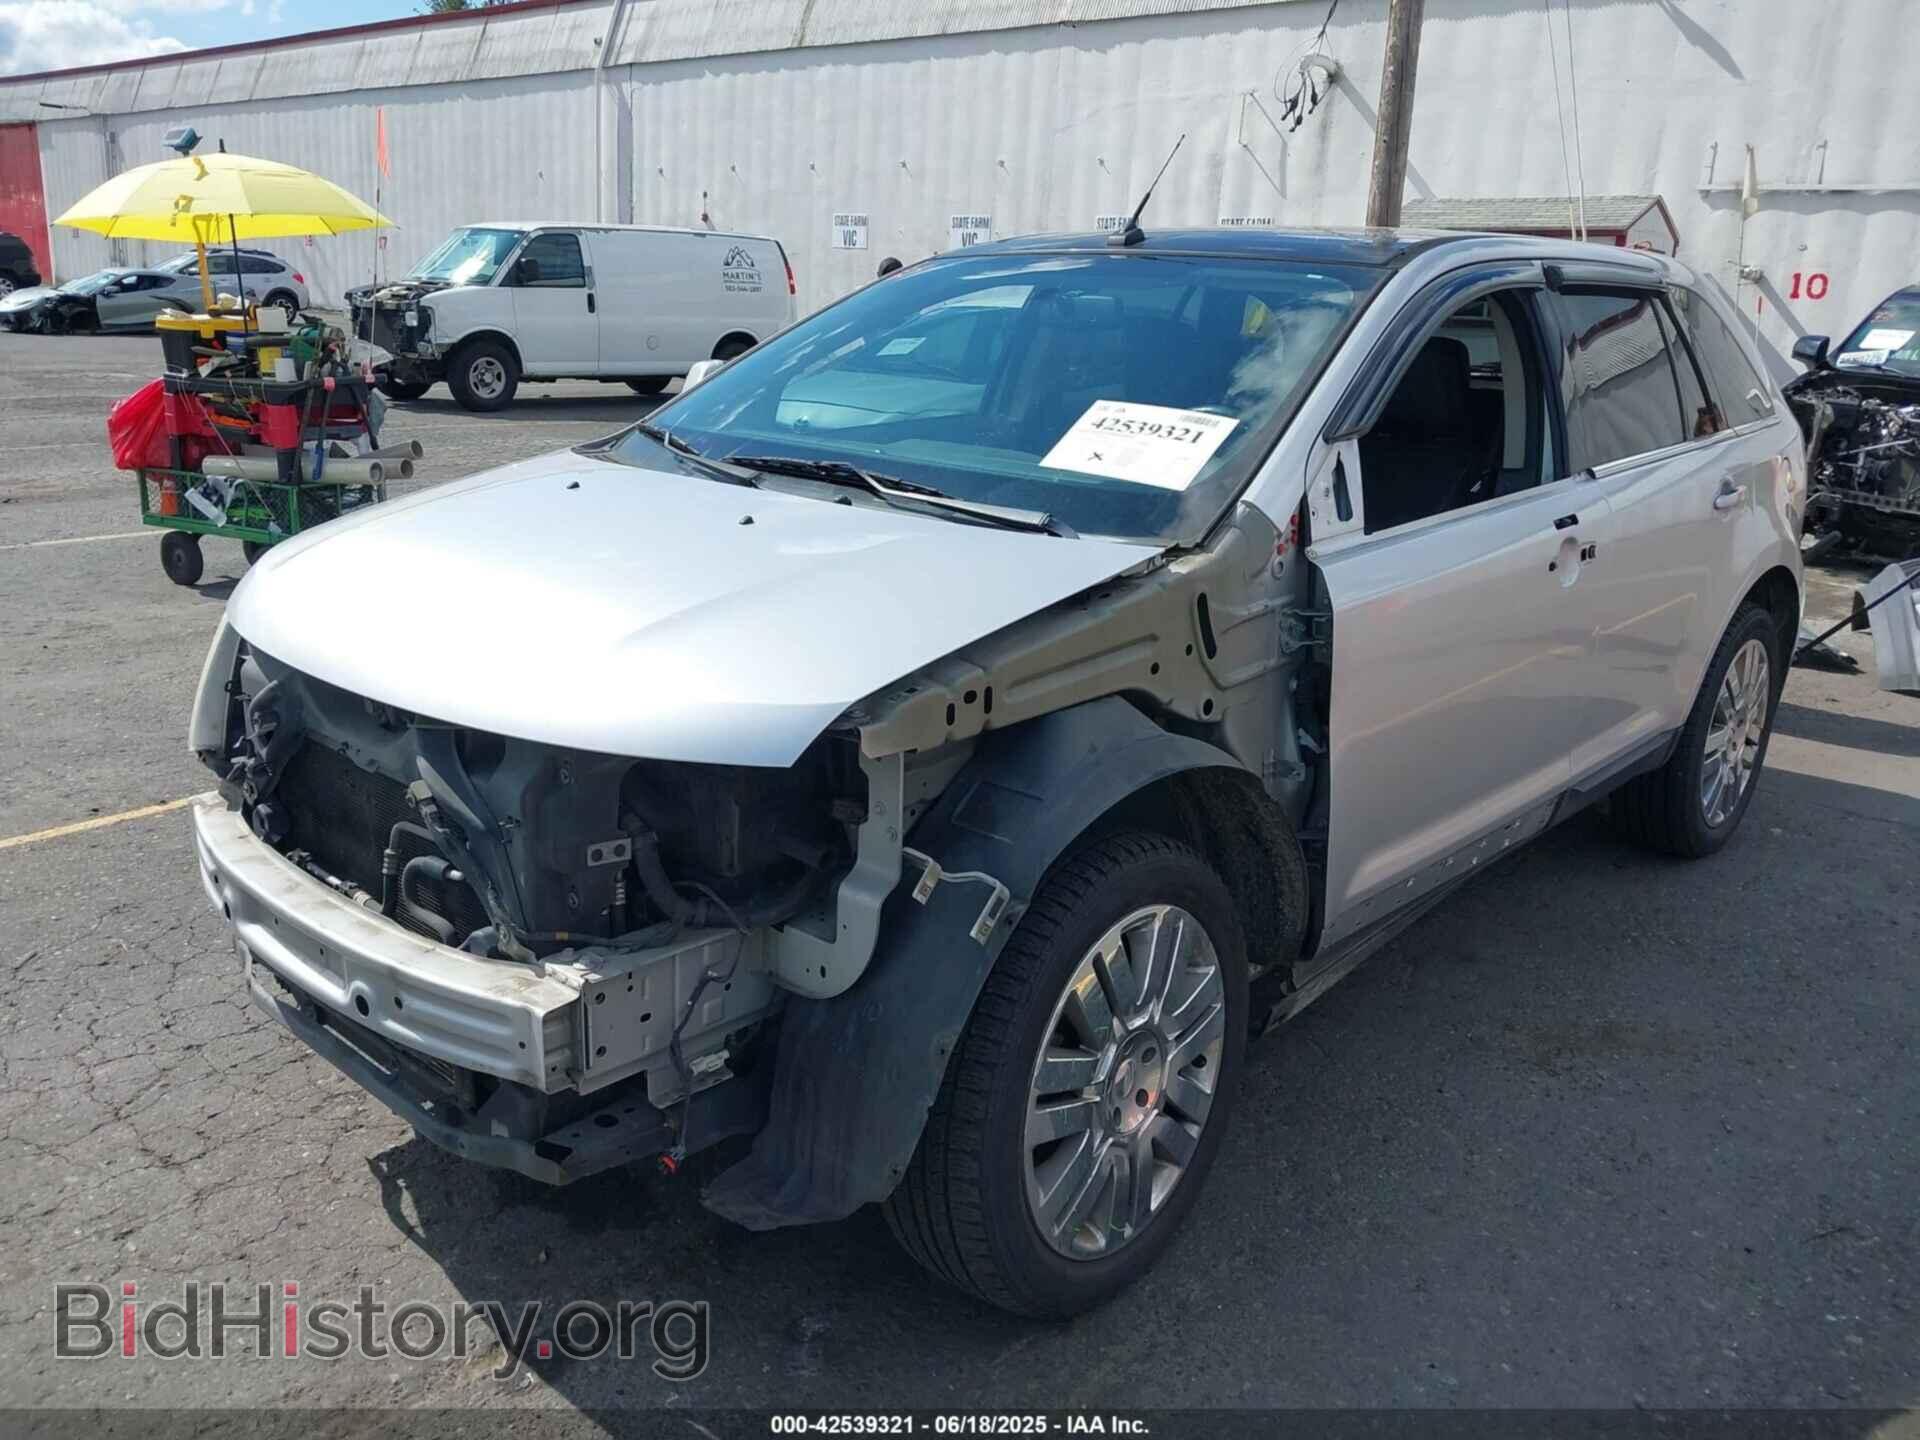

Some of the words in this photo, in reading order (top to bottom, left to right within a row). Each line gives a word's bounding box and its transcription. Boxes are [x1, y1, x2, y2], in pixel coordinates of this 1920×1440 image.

[834, 215, 849, 226] STATE
[850, 215, 868, 226] FARM
[952, 216, 969, 229] STATE
[971, 216, 990, 229] FARM
[842, 229, 857, 247] VIC
[961, 231, 978, 248] VIC
[1790, 272, 1828, 300] 10
[1091, 416, 1205, 444] 42539321
